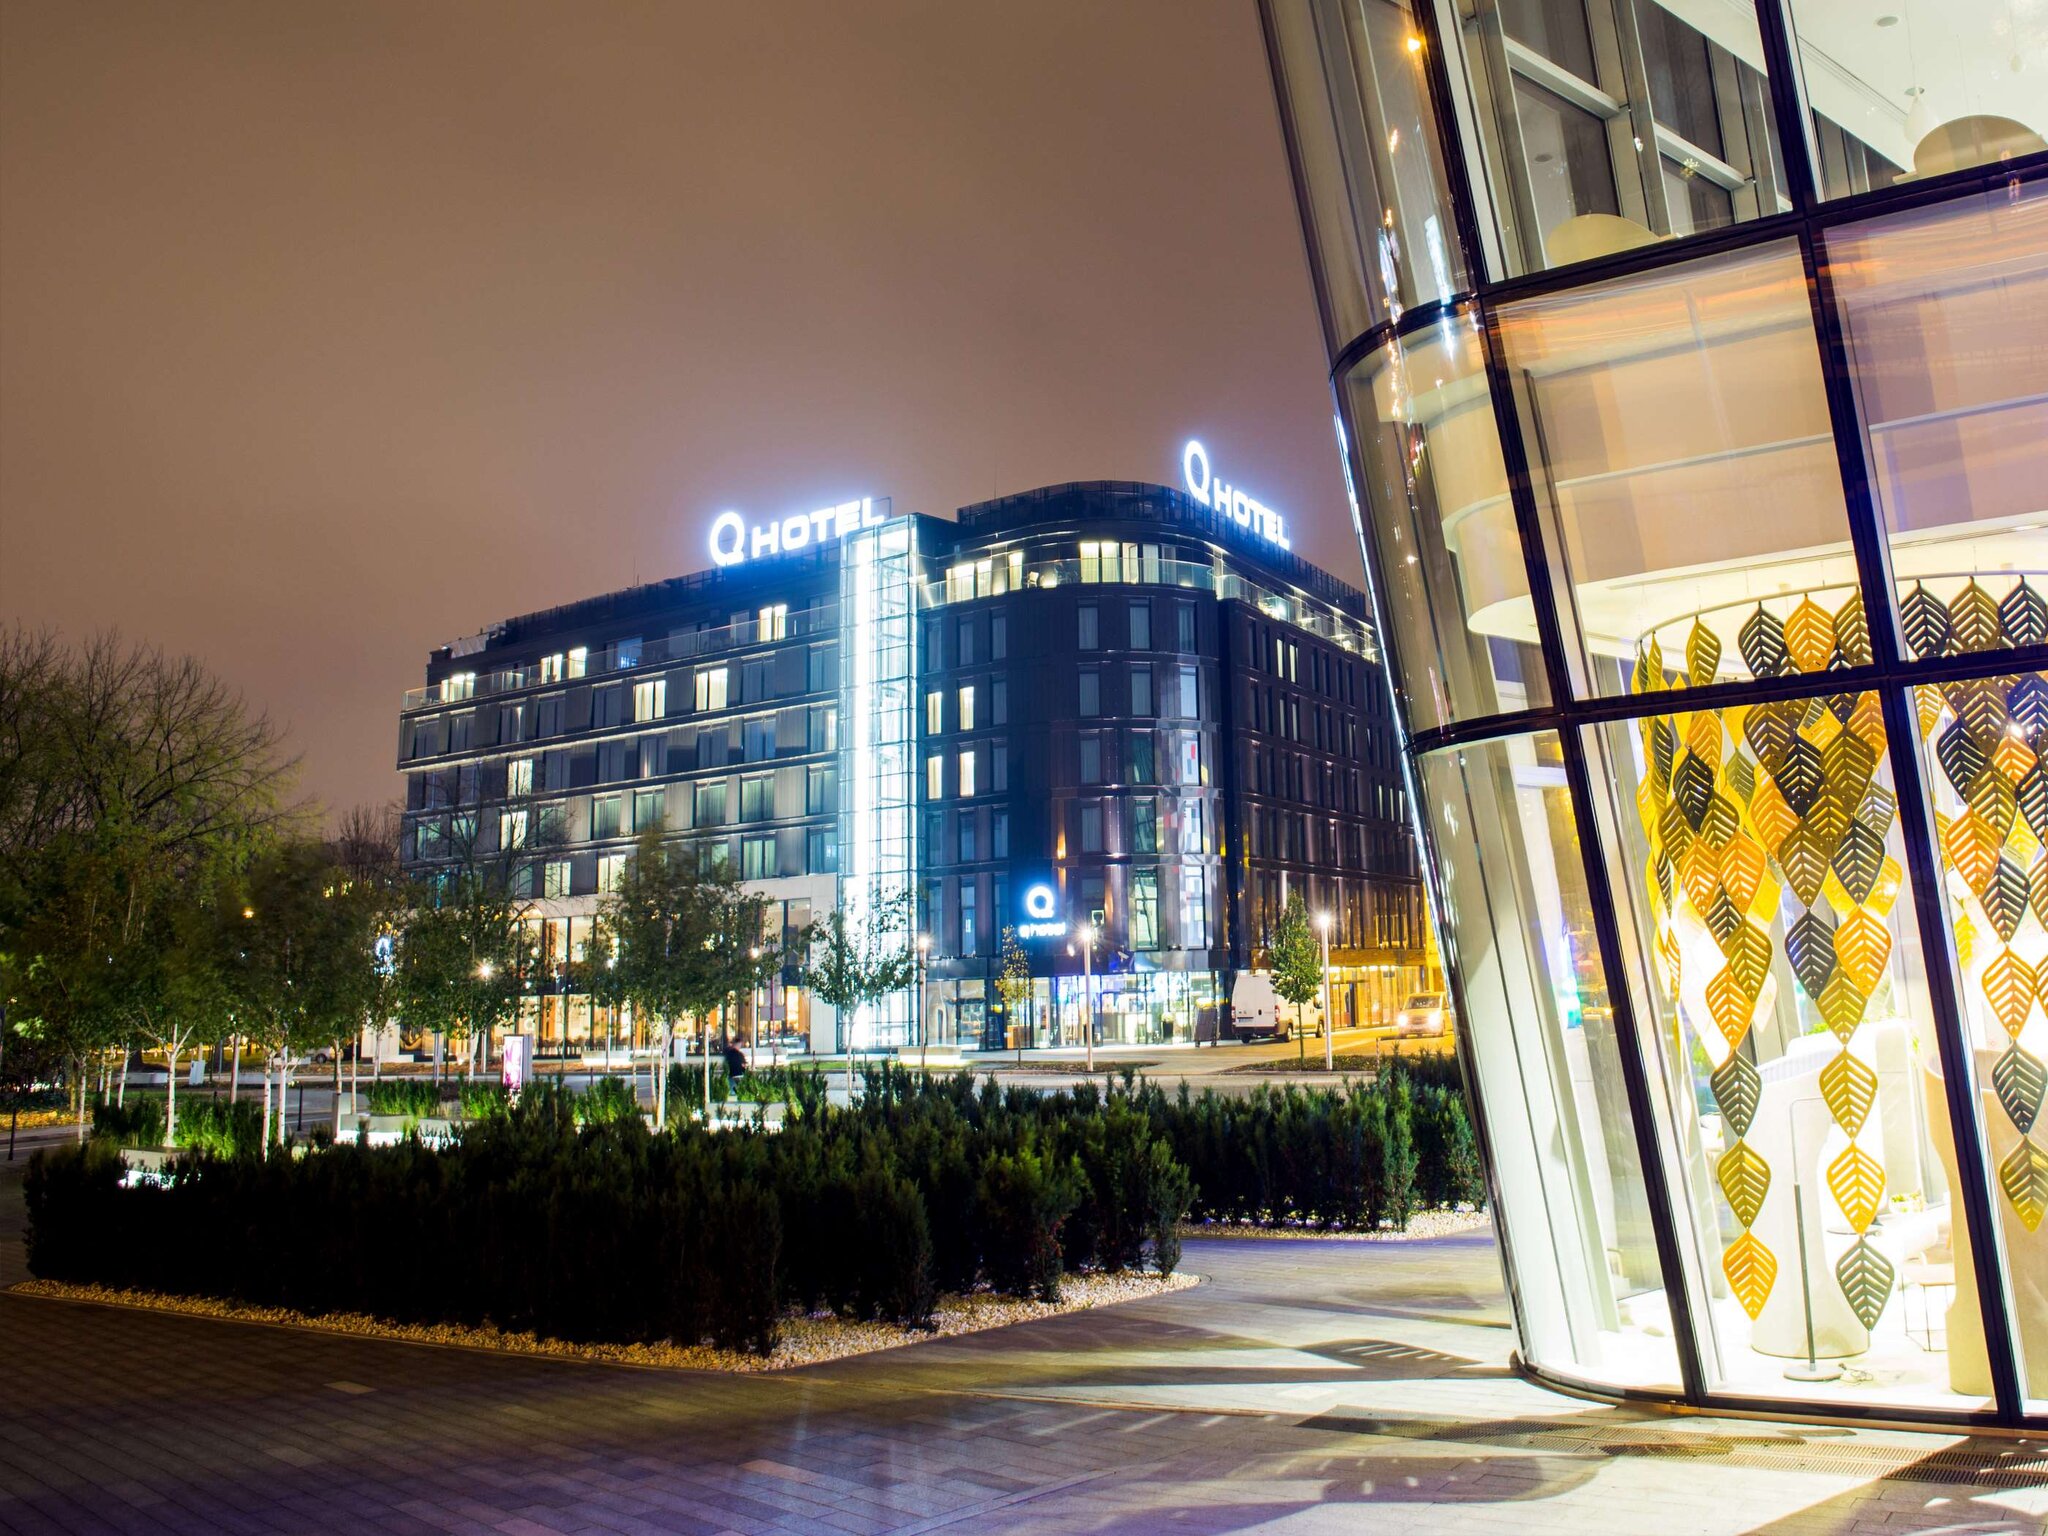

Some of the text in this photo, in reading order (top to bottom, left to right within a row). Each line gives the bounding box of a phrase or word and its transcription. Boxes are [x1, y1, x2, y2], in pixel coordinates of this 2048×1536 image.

[1184, 440, 1290, 551] Q HOTEL
[709, 497, 885, 566] Q HOTEL
[1026, 885, 1054, 919] Q
